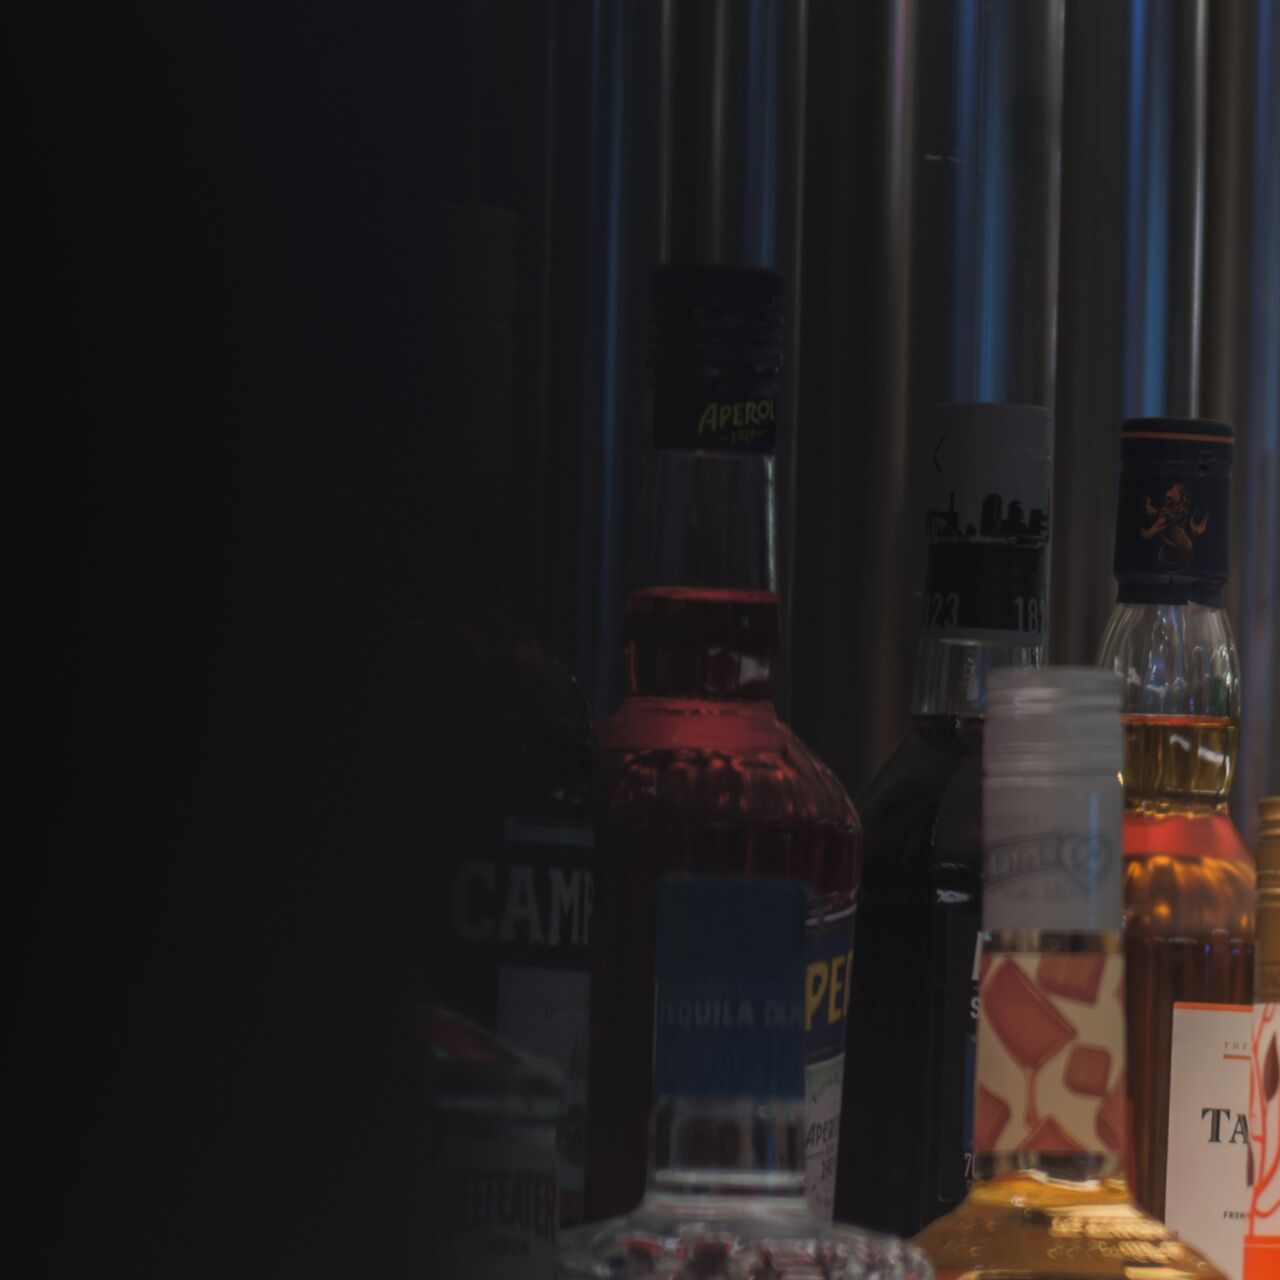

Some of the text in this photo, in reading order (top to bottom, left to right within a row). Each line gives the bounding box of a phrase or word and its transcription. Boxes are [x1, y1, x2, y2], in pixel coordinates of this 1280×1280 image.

[697, 400, 776, 434] APEROL
[1014, 597, 1048, 633] 18
[1223, 1042, 1249, 1052] THE
[1201, 1107, 1250, 1145] TA
